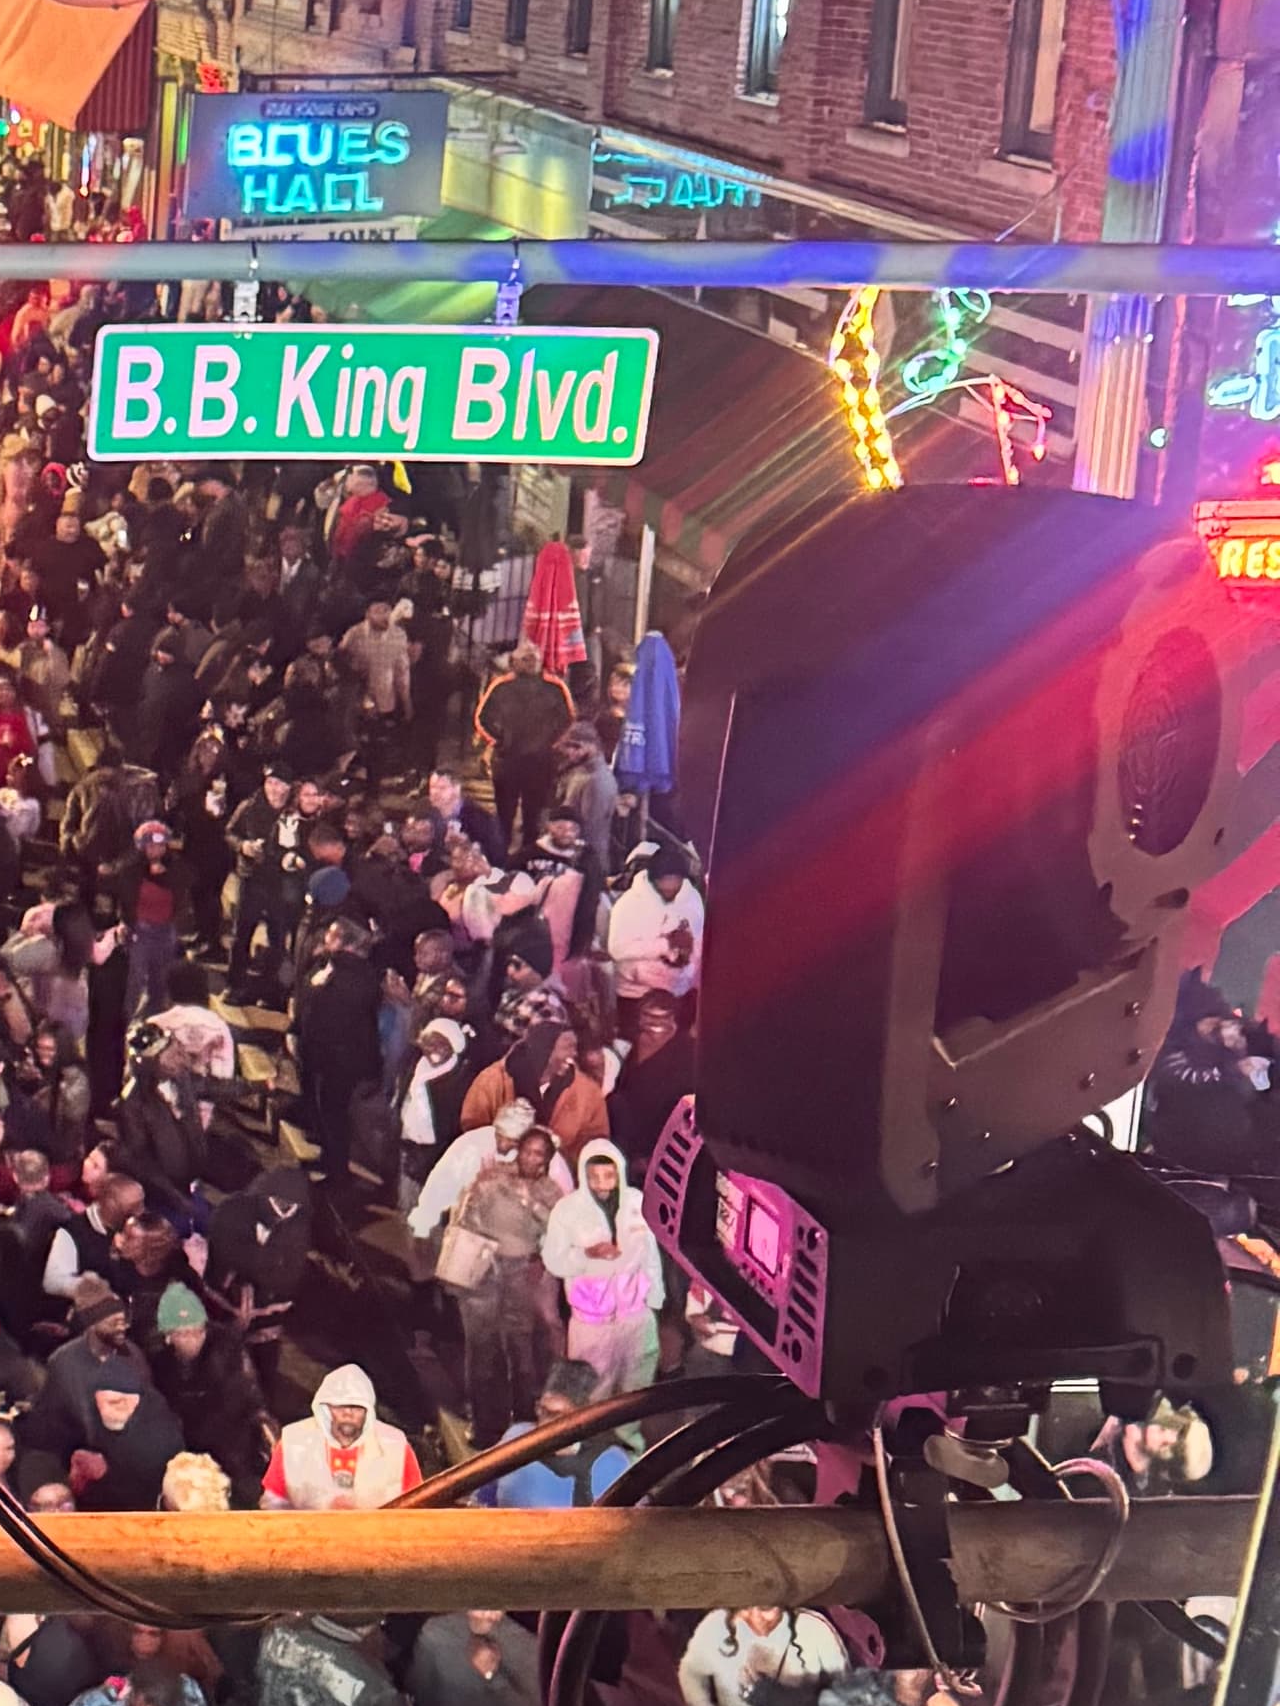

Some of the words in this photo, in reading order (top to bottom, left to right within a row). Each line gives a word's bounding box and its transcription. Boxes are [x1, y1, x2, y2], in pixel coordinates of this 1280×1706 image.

[227, 120, 411, 167] BLUES
[243, 172, 384, 214] HALL
[111, 345, 257, 439] B.B.
[276, 343, 427, 451] King
[452, 347, 629, 444] Blvd.
